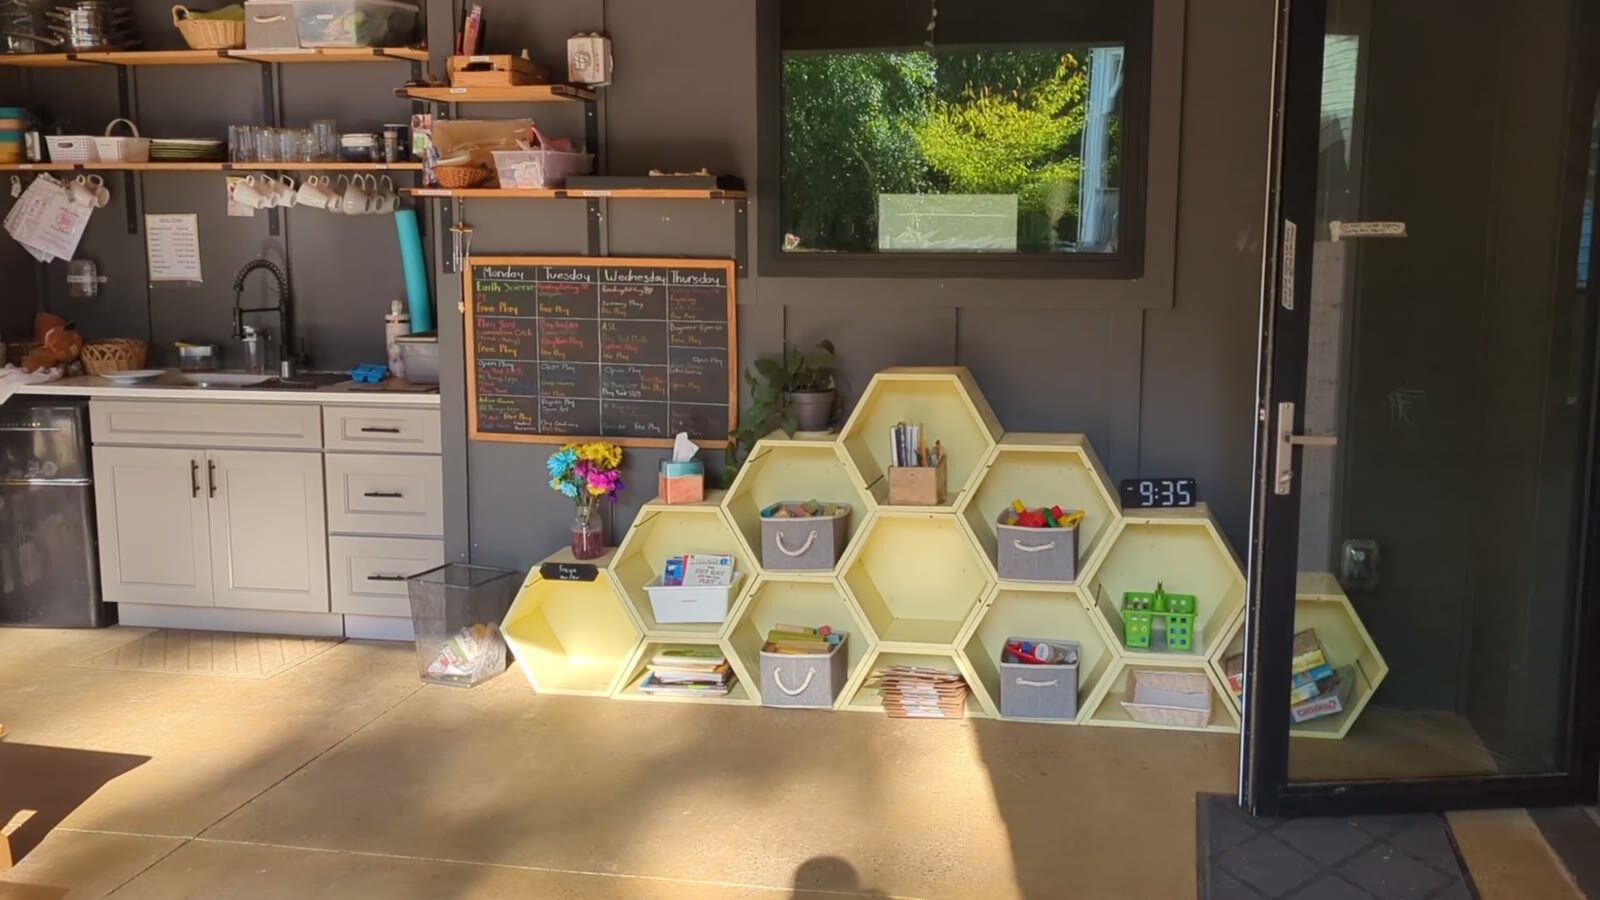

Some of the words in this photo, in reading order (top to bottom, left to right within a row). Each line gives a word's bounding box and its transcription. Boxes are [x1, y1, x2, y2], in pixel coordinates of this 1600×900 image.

[483, 266, 524, 280] Monday
[543, 267, 590, 282] Tuesday
[605, 269, 665, 285] Wednesday
[670, 270, 719, 286] Thursday
[476, 281, 500, 292] Earth
[476, 303, 495, 312] Free
[499, 302, 518, 315] Play
[477, 342, 495, 352] Free
[500, 344, 518, 357] Play
[1140, 481, 1190, 506] 9:35
